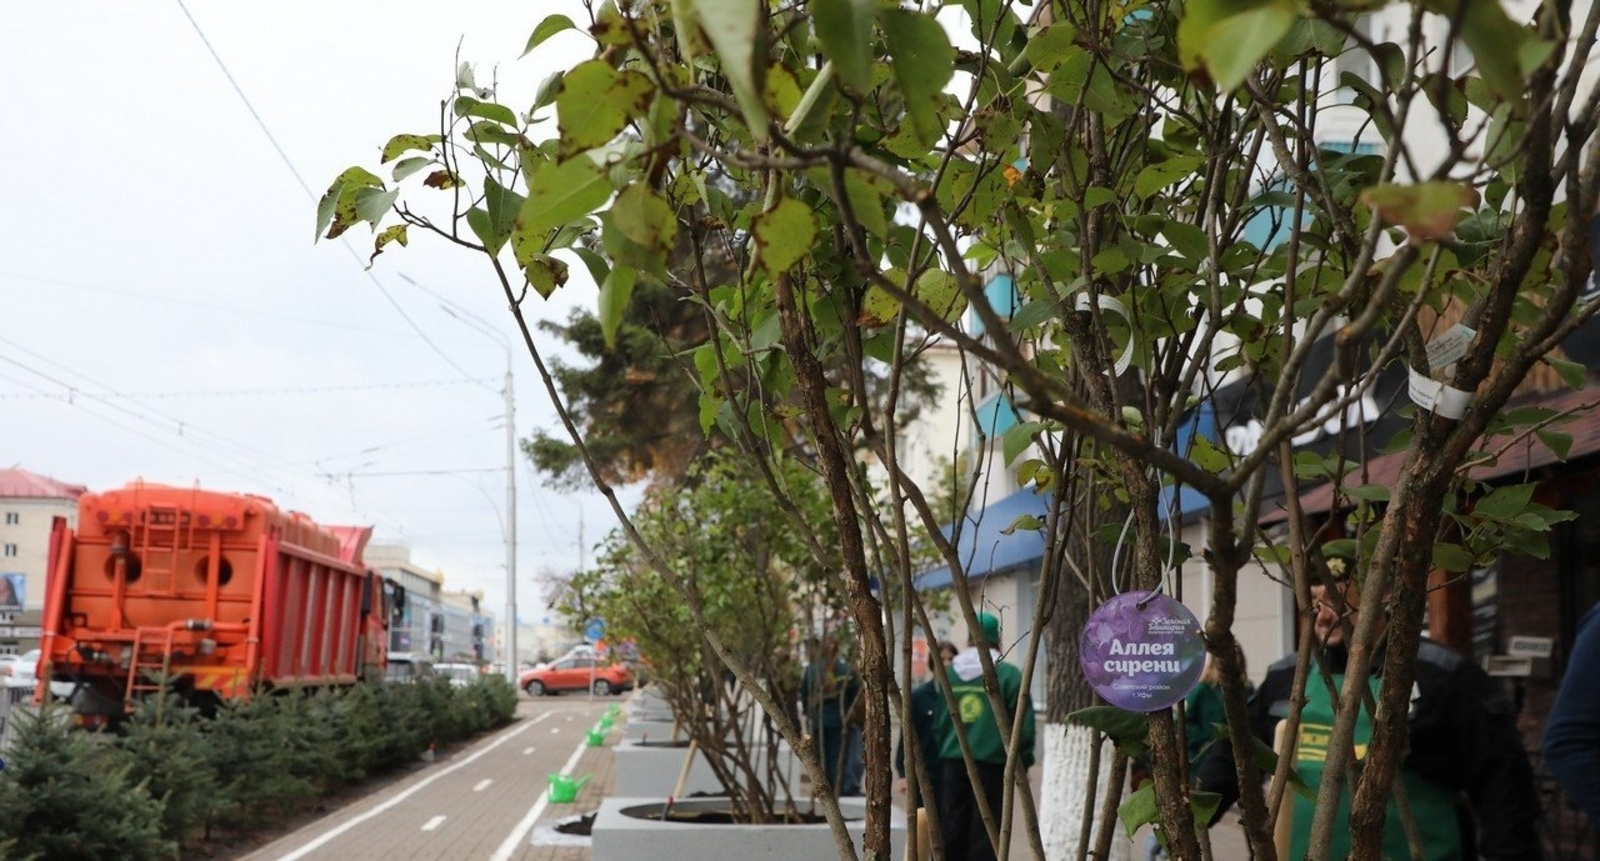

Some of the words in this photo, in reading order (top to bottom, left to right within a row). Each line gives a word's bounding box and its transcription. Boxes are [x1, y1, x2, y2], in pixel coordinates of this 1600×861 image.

[1109, 638, 1175, 656] Аллея
[1103, 660, 1181, 677] сирени
[1112, 683, 1148, 691] Советский
[1149, 683, 1171, 692] район
